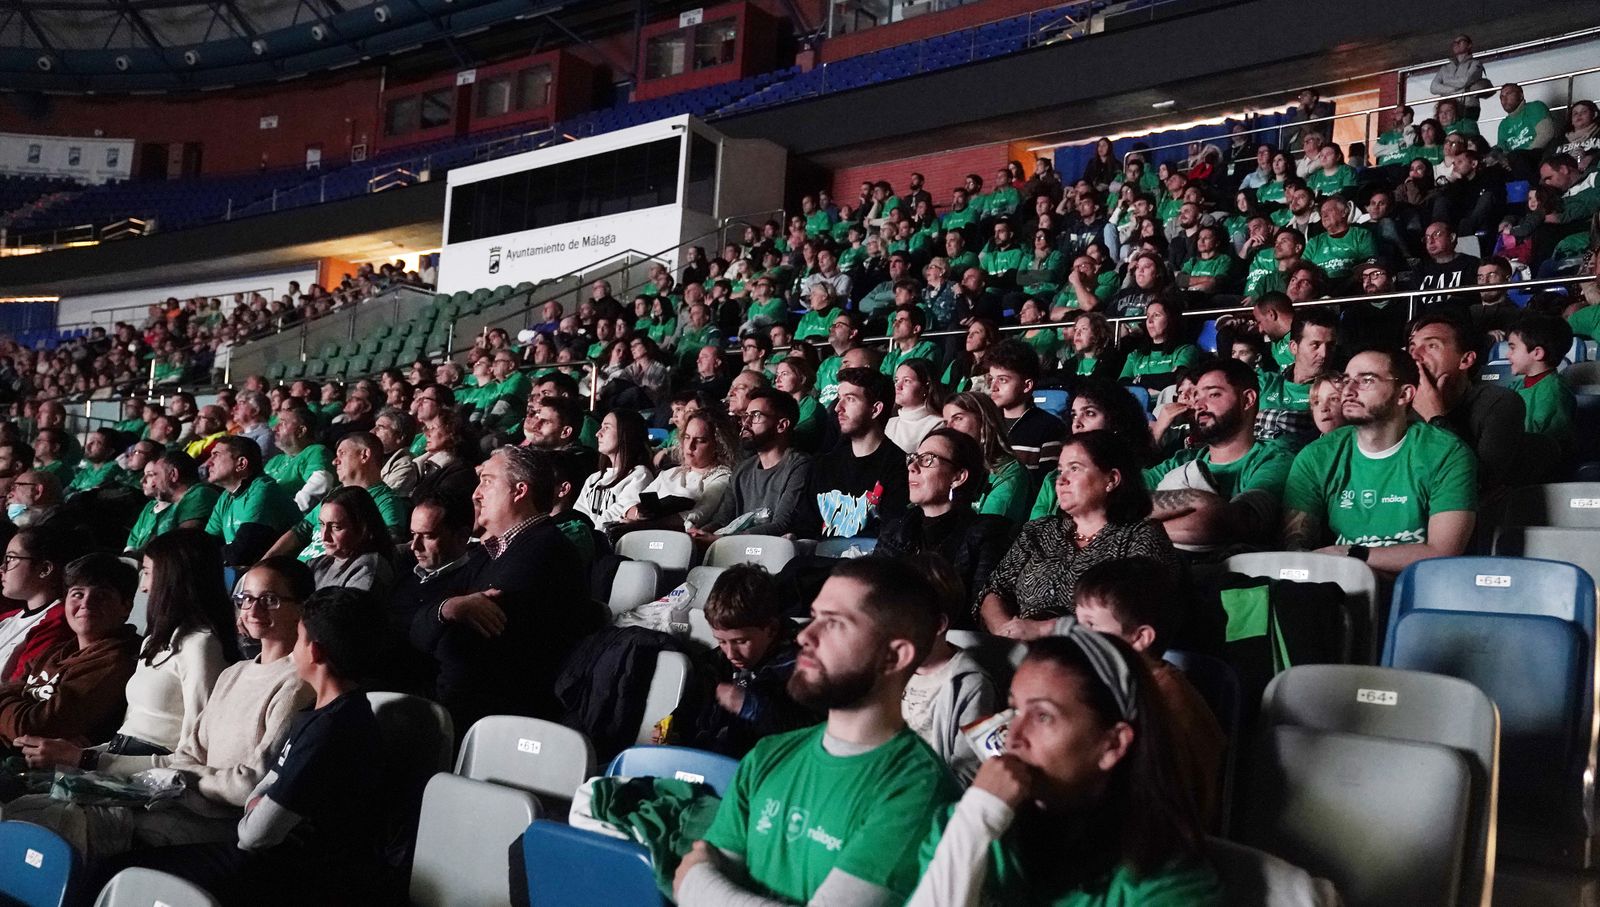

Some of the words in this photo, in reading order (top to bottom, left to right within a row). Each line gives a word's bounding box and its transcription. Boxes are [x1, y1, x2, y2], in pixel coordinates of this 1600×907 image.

[506, 243, 566, 261] Ayuntamiento
[568, 240, 580, 250] de
[582, 234, 617, 247] Málaga
[1341, 490, 1355, 500] 30
